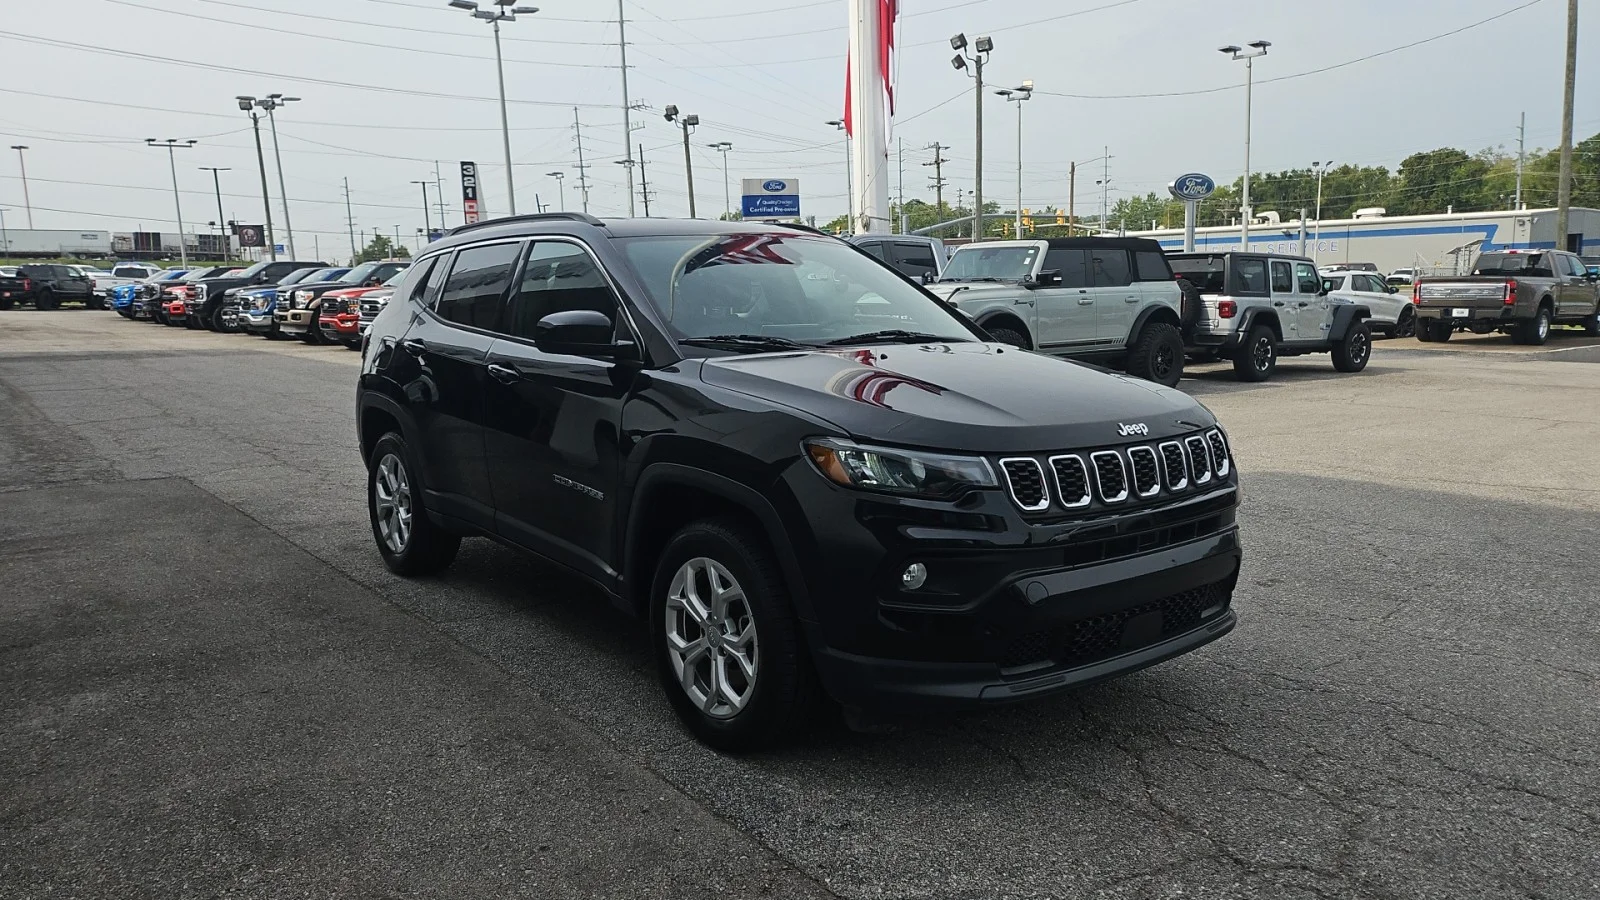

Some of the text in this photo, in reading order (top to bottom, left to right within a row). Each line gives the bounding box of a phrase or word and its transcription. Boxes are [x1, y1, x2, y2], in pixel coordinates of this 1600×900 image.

[768, 182, 783, 190] Ford
[1183, 178, 1208, 194] Ford
[1117, 422, 1149, 436] Jeep
